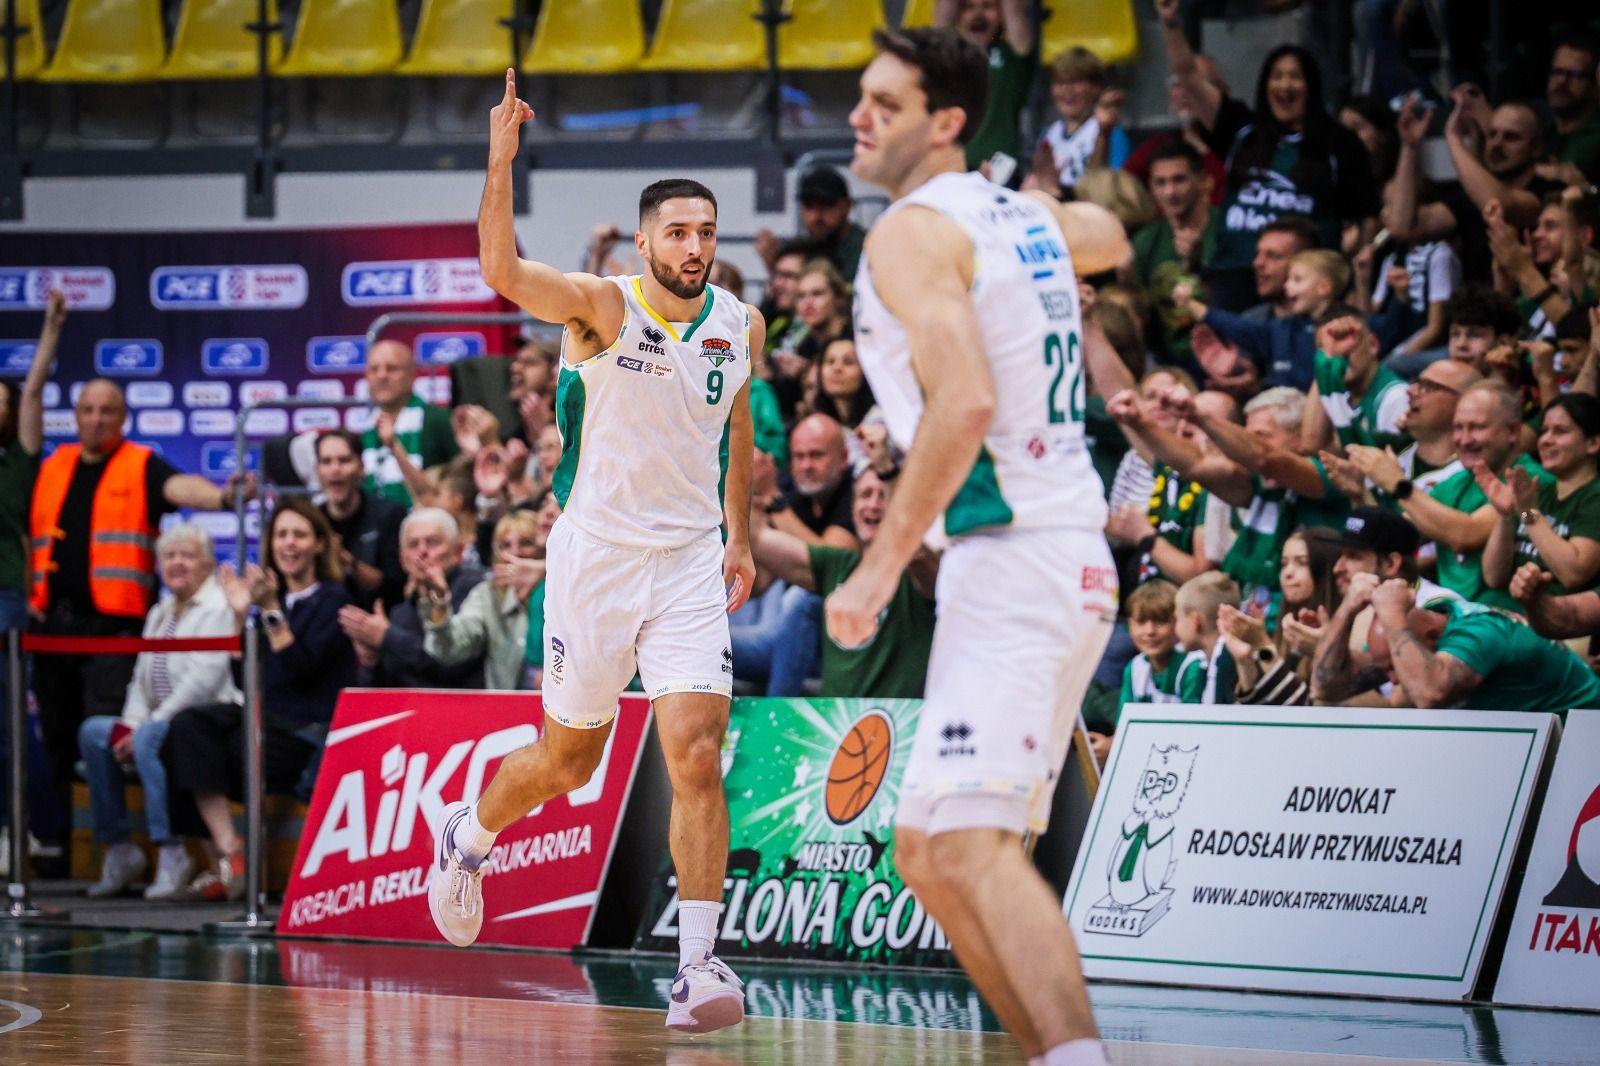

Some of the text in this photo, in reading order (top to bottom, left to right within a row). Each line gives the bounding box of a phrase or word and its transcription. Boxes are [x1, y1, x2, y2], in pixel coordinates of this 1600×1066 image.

[620, 358, 641, 370] PGE
[1045, 332, 1084, 424] 22
[706, 370, 724, 405] 9
[691, 682, 712, 690] 2026
[586, 719, 602, 728] 1946
[1283, 786, 1396, 814] ADWOKAT
[797, 842, 873, 873] MIASTO
[1187, 828, 1463, 866] RADOSŁAW PRZYMUSZAŁA
[287, 880, 366, 928] KREACJA
[486, 824, 592, 877] RUKARNIA
[1192, 886, 1429, 915] WWW.ADWOKATPRZYMUSZALA.PL
[1088, 914, 1137, 931] KODEKS
